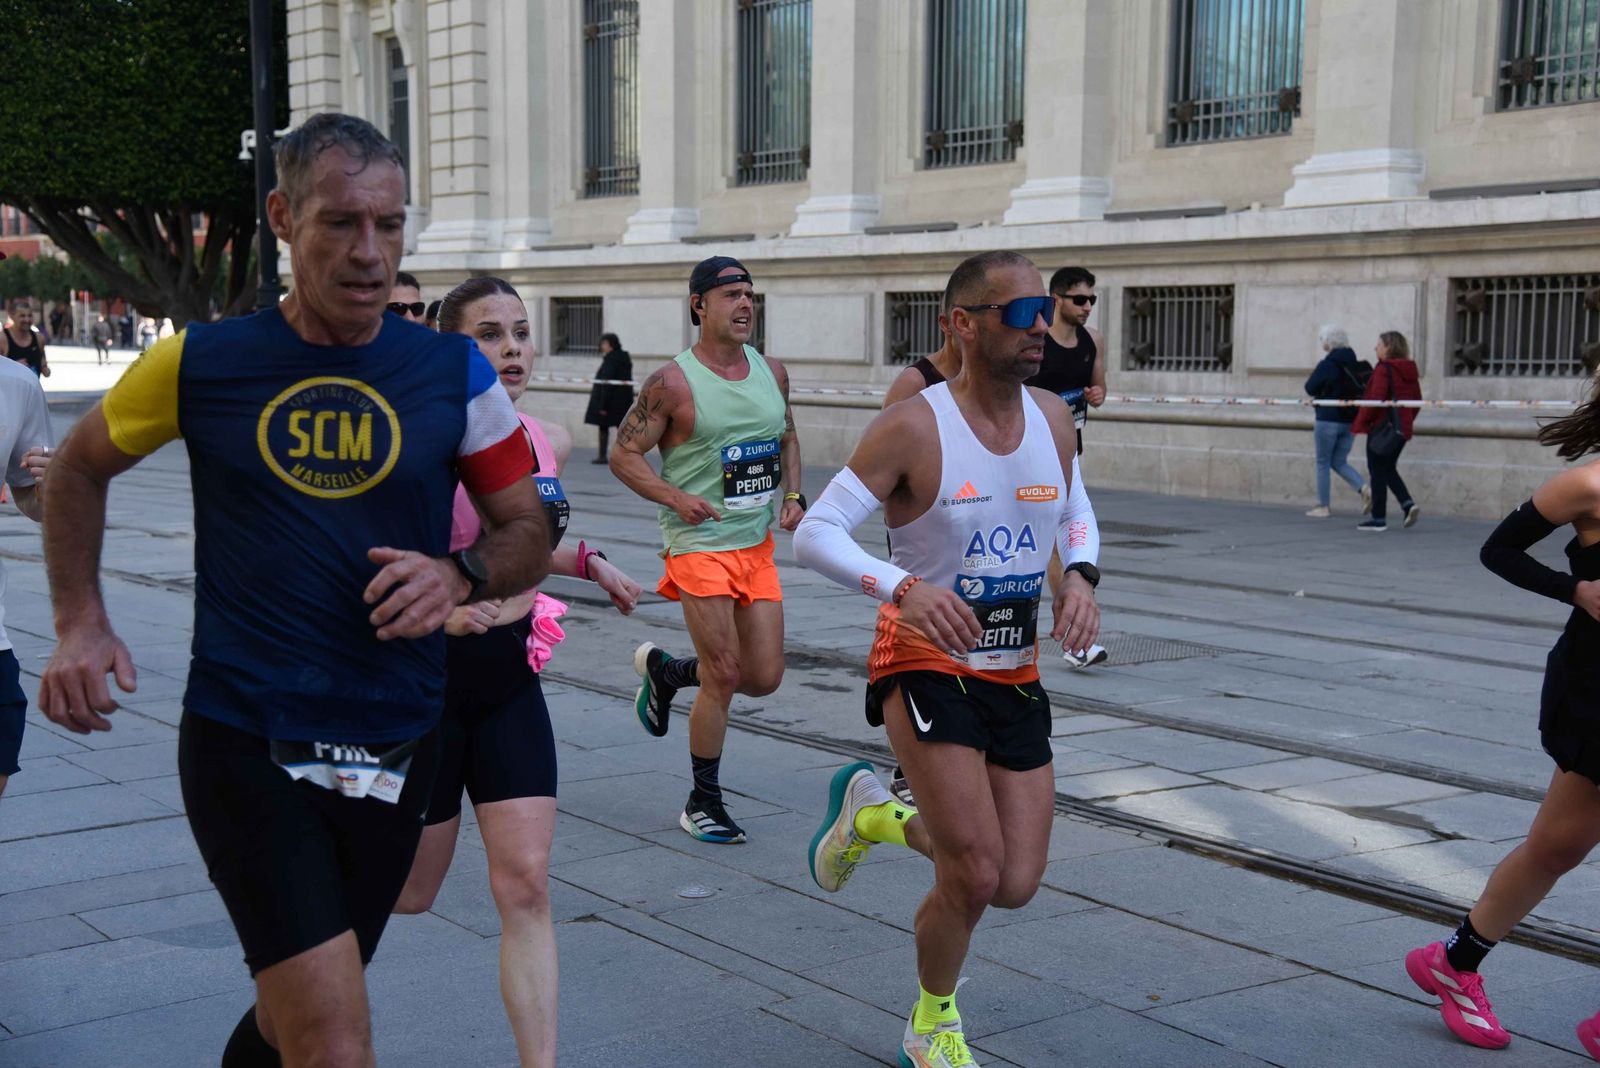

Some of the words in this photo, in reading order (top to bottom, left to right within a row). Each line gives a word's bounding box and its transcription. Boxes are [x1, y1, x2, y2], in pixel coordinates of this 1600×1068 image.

[288, 410, 373, 461] SCM
[745, 443, 775, 456] ZURICH
[290, 463, 368, 489] MARSEILLE
[747, 464, 764, 475] 4866
[537, 483, 556, 496] ICH
[736, 475, 772, 494] PEPITO
[951, 496, 992, 505] EUROSPORT
[964, 524, 1037, 563] AQA
[992, 580, 1037, 596] ZURICH
[987, 608, 1013, 623] 4548
